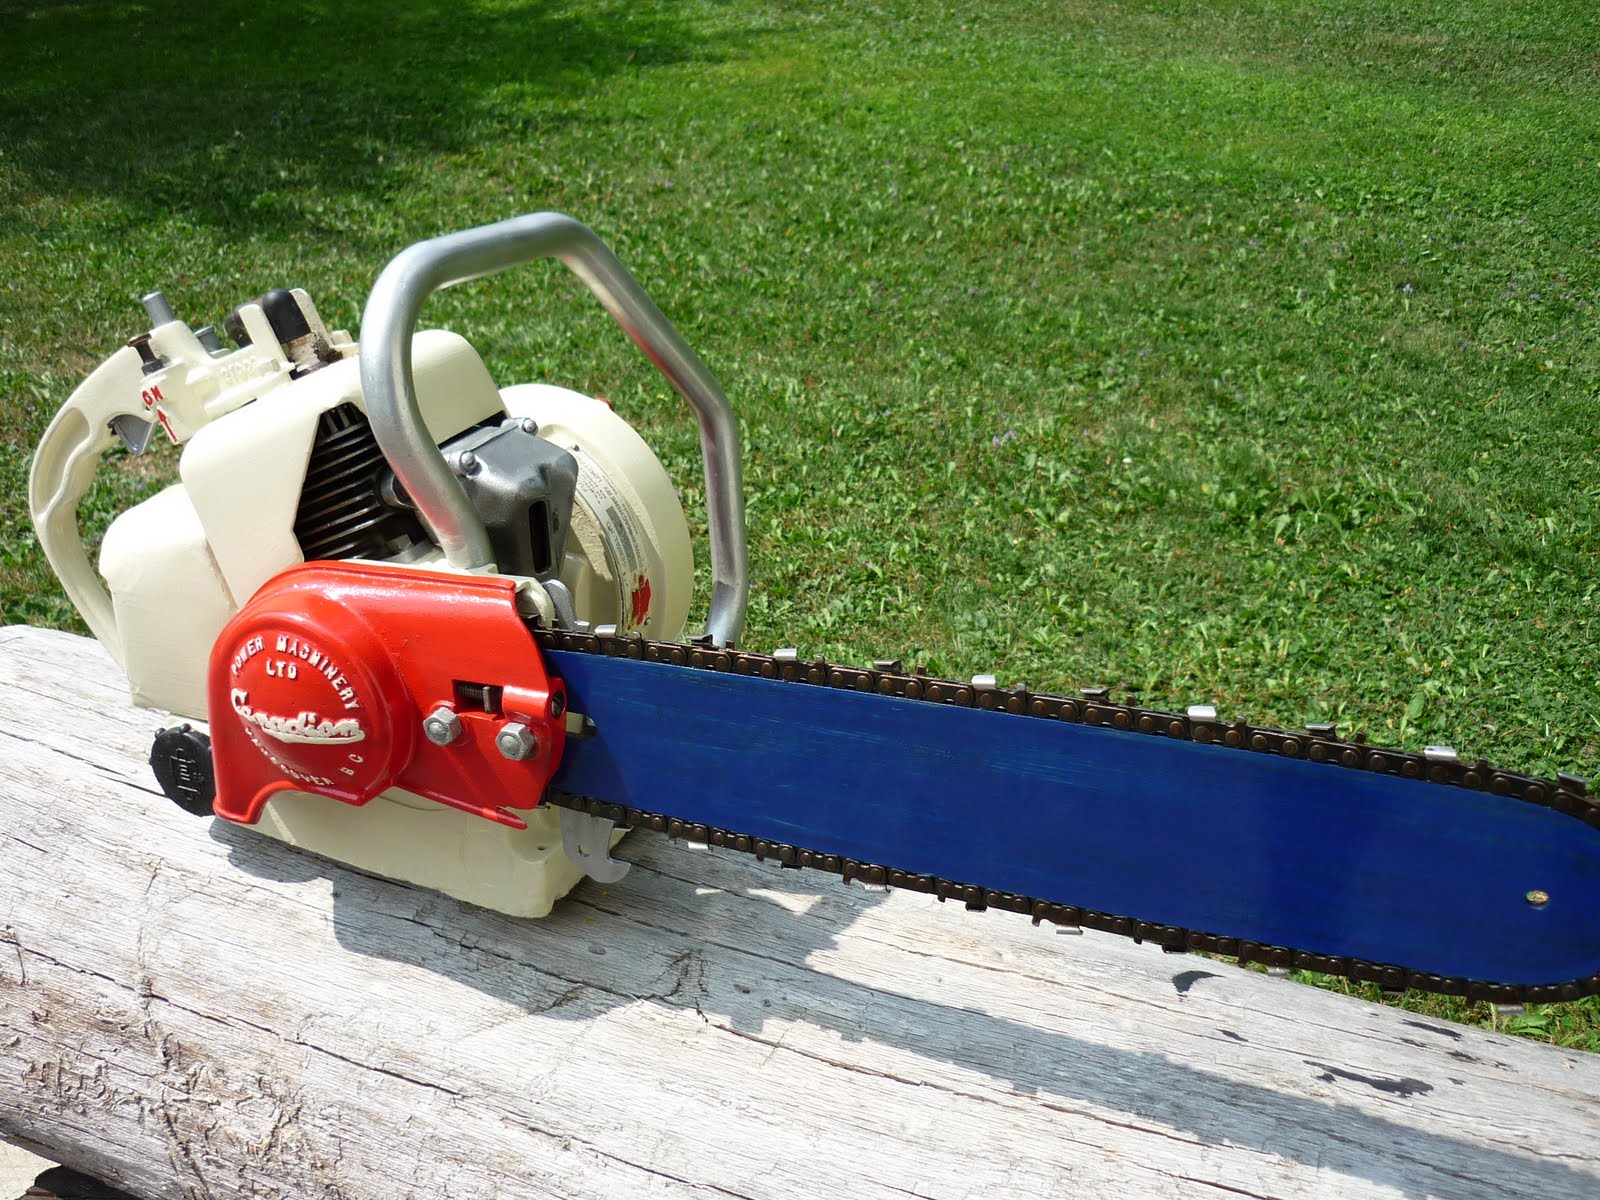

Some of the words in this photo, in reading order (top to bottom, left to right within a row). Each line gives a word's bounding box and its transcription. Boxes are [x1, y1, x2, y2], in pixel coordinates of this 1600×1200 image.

[142, 385, 164, 406] ON
[231, 636, 264, 677] POWER
[266, 658, 298, 680] LTD
[231, 688, 366, 745] Canadian
